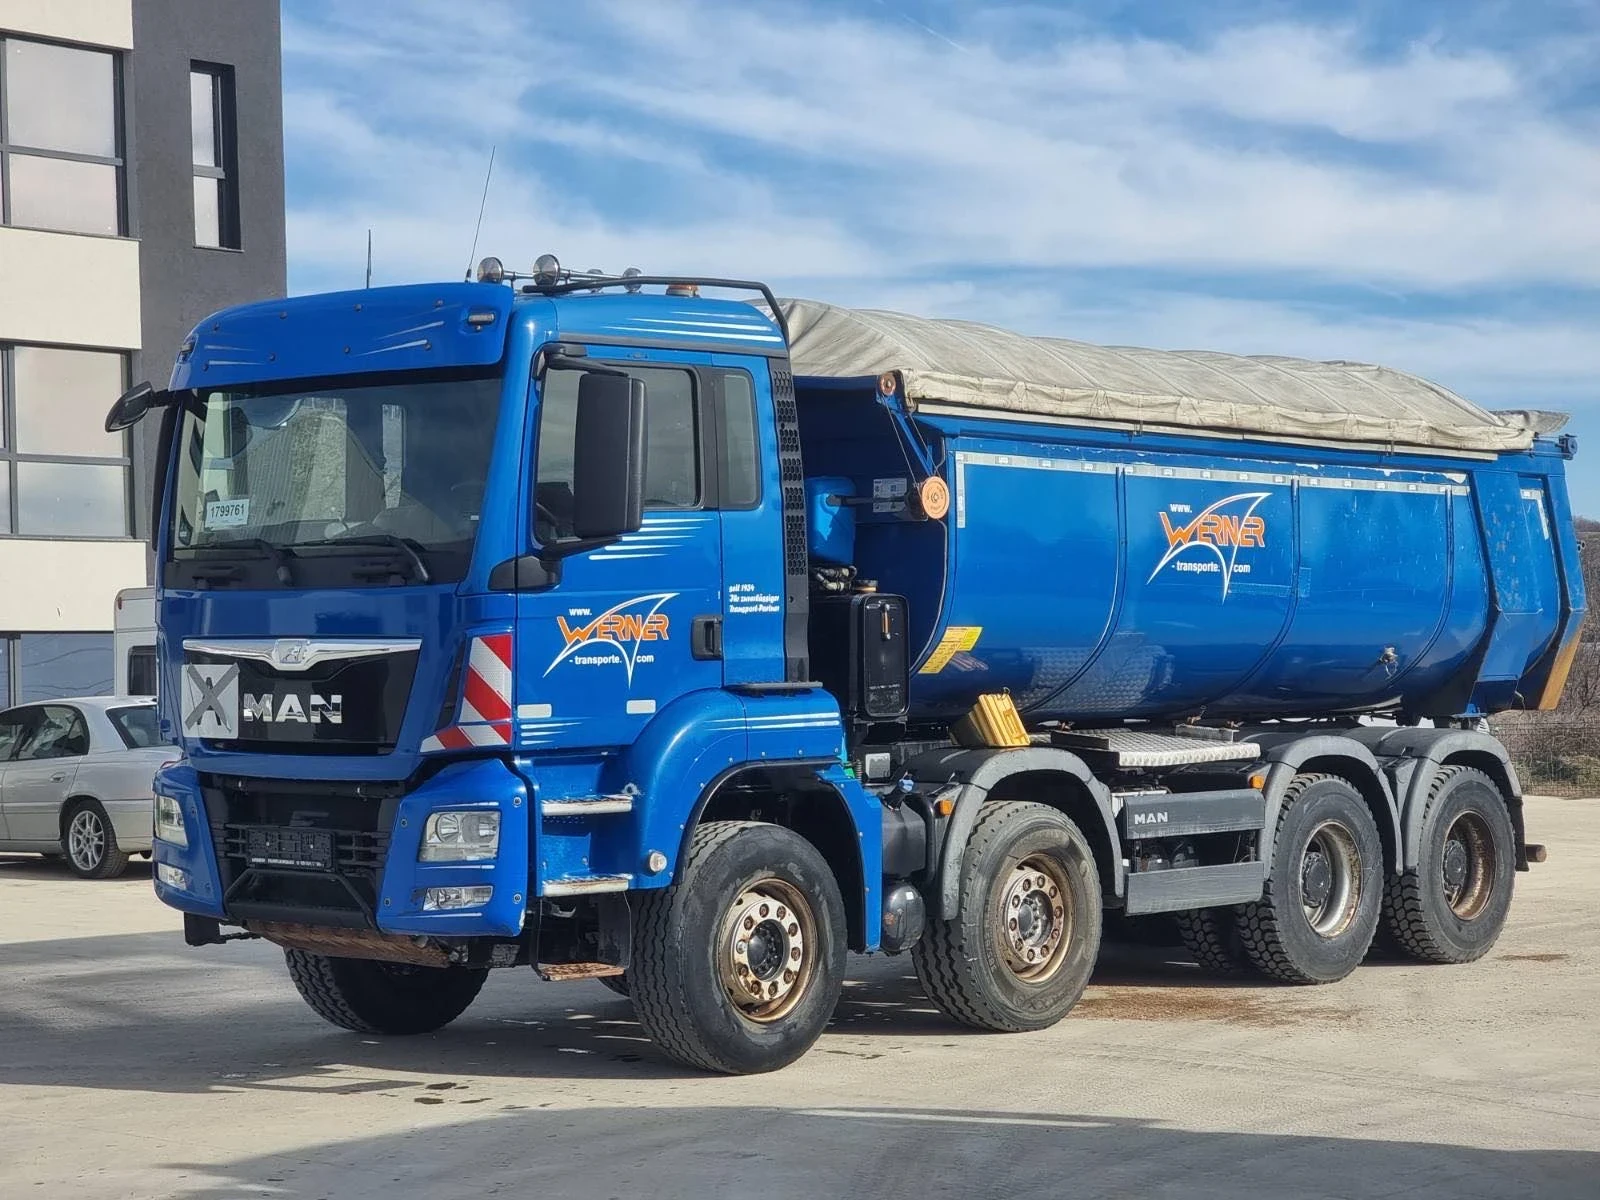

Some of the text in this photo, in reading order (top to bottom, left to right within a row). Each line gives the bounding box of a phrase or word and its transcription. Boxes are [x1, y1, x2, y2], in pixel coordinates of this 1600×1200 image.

[210, 503, 245, 518] 1799761
[1170, 503, 1192, 513] www.
[1158, 511, 1266, 548] WERNER
[568, 608, 592, 617] www.
[556, 613, 670, 645] WERNER
[243, 693, 343, 724] MAN
[1134, 811, 1169, 825] MAN
